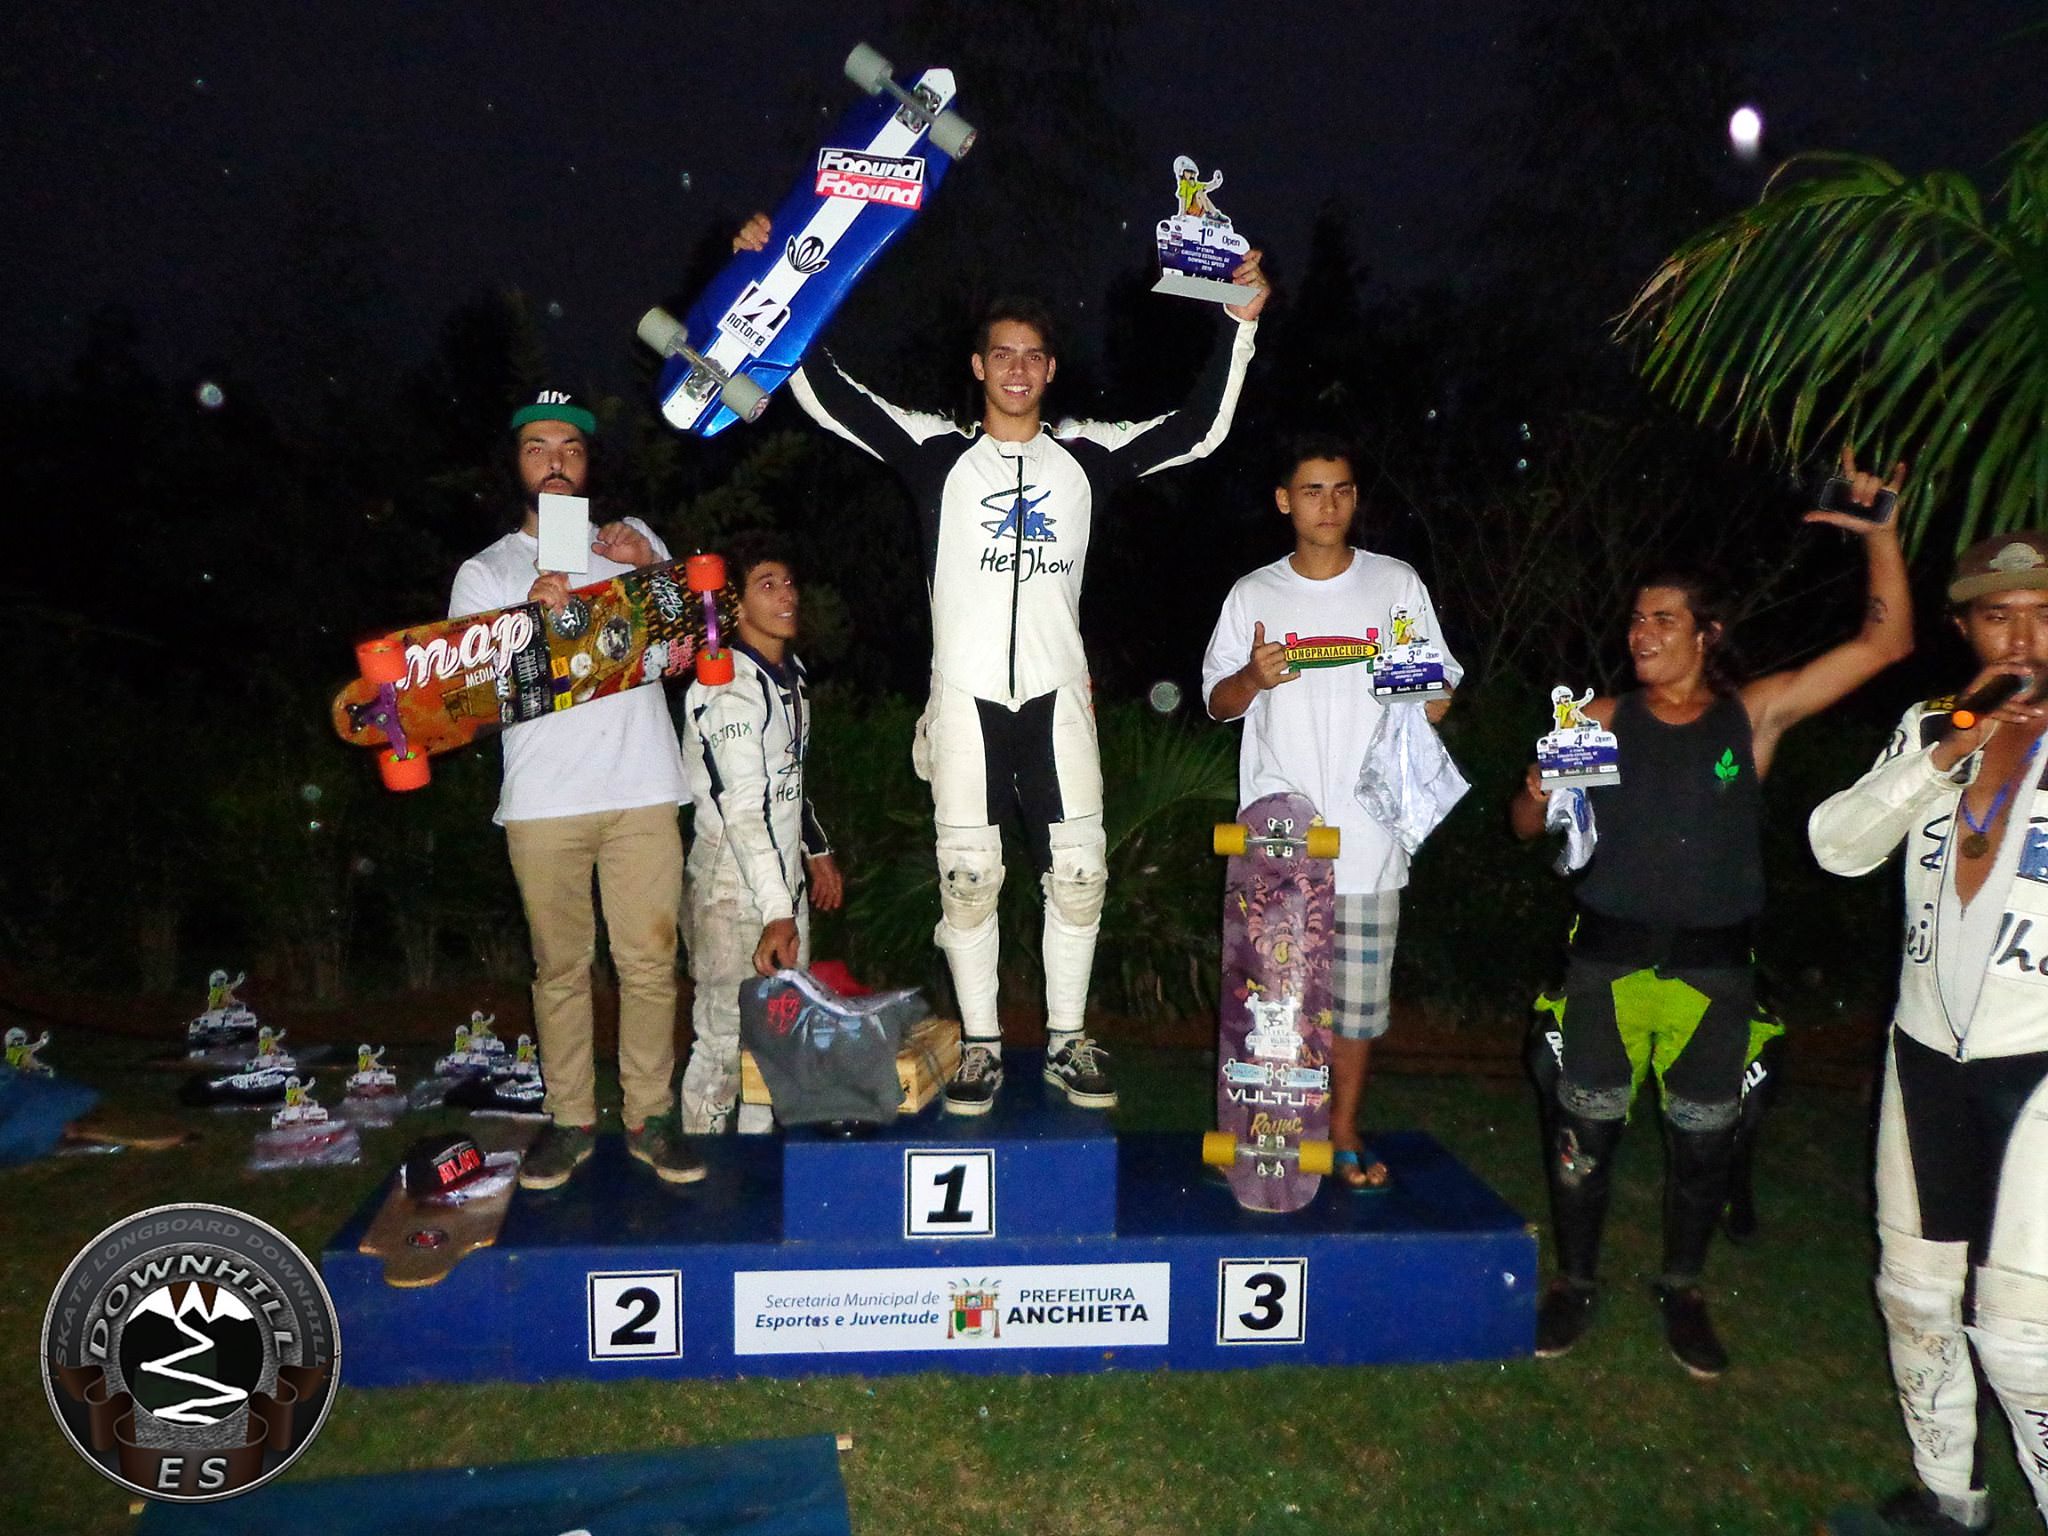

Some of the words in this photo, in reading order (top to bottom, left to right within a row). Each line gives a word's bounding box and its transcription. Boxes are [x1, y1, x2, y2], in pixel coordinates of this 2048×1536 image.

[821, 151, 921, 180] Foound
[816, 172, 922, 206] Foound
[1222, 235, 1240, 247] Open
[465, 665, 497, 687] MEDIA
[926, 1164, 975, 1223] 1
[765, 1294, 840, 1309] Secretaria
[843, 1291, 918, 1308] Municipal
[921, 1291, 940, 1305] de
[1020, 1287, 1136, 1303] PREFEITURA
[1238, 1271, 1288, 1331] 3
[610, 1286, 661, 1346] 2
[755, 1313, 830, 1331] Esportes
[834, 1315, 845, 1326] e
[849, 1310, 940, 1326] Juventude
[1006, 1304, 1149, 1325] ANCHIETA
